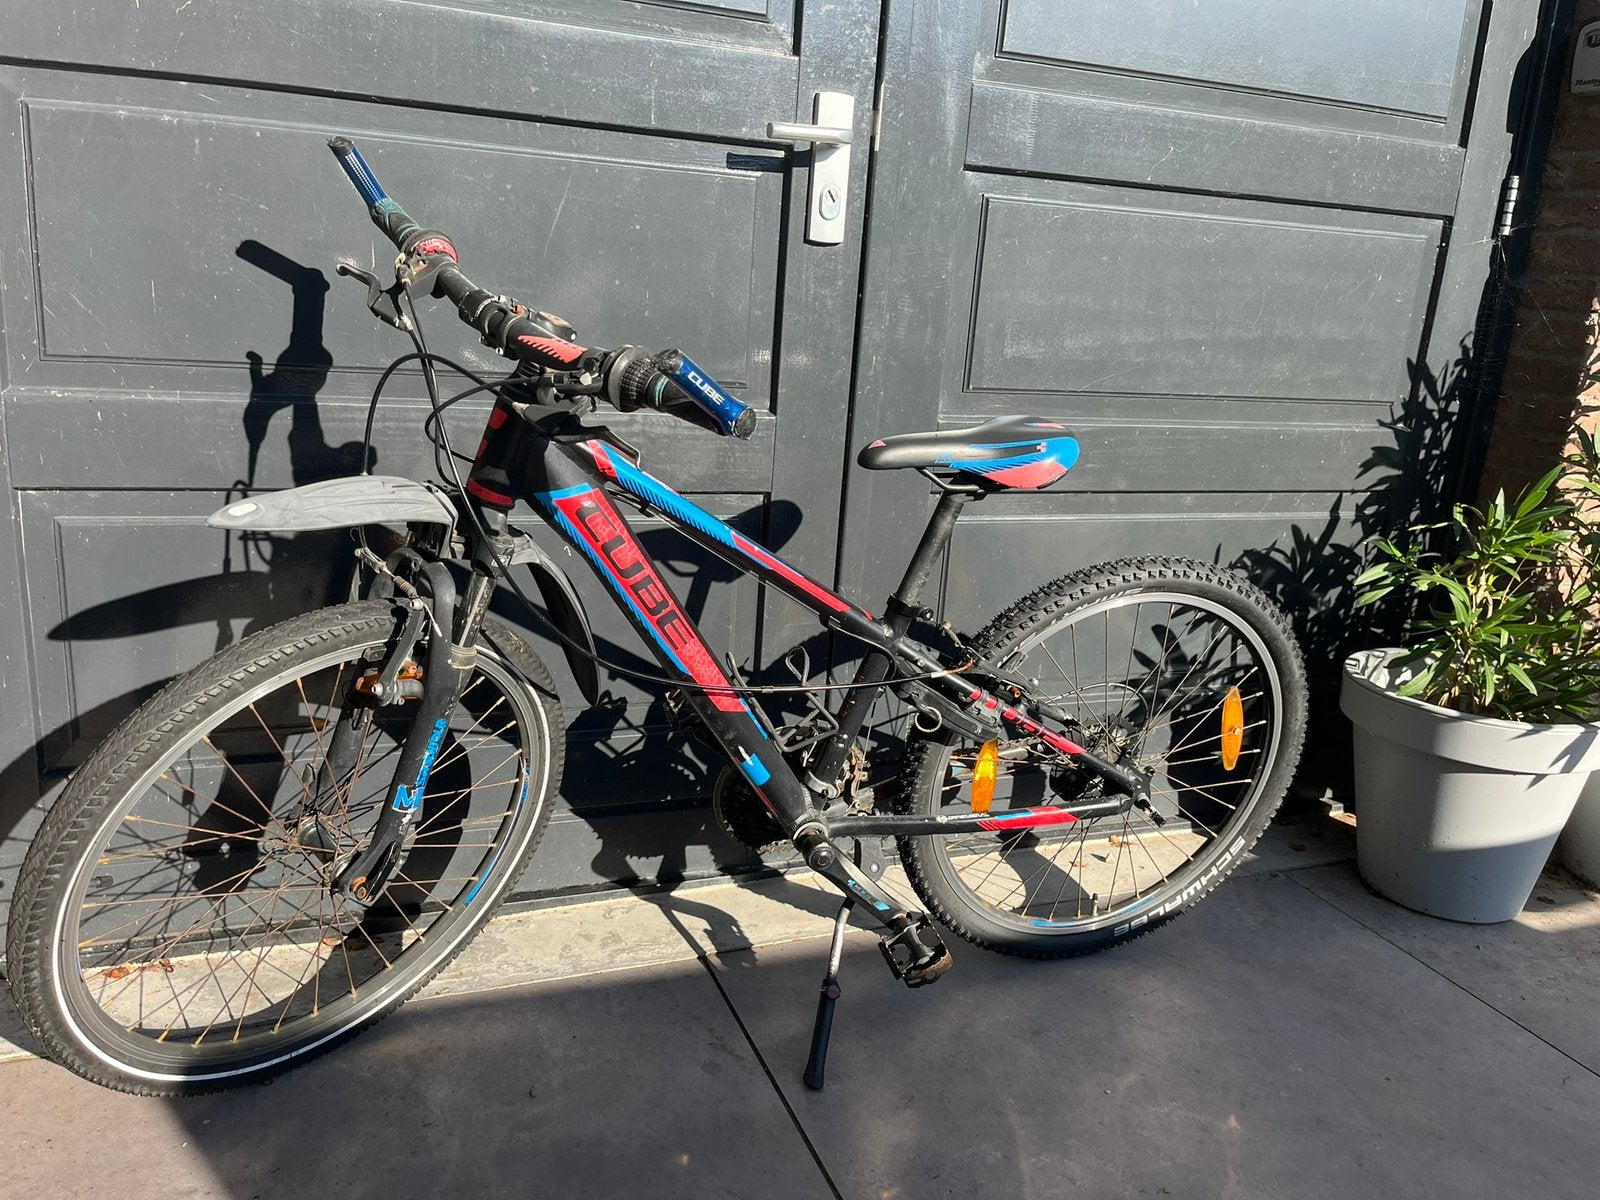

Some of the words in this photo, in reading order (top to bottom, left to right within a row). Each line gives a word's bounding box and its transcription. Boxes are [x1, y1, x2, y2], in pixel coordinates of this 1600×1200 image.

[687, 371, 725, 406] CUBE
[574, 502, 695, 651] CUBE
[1114, 836, 1245, 937] SCHWALBE
